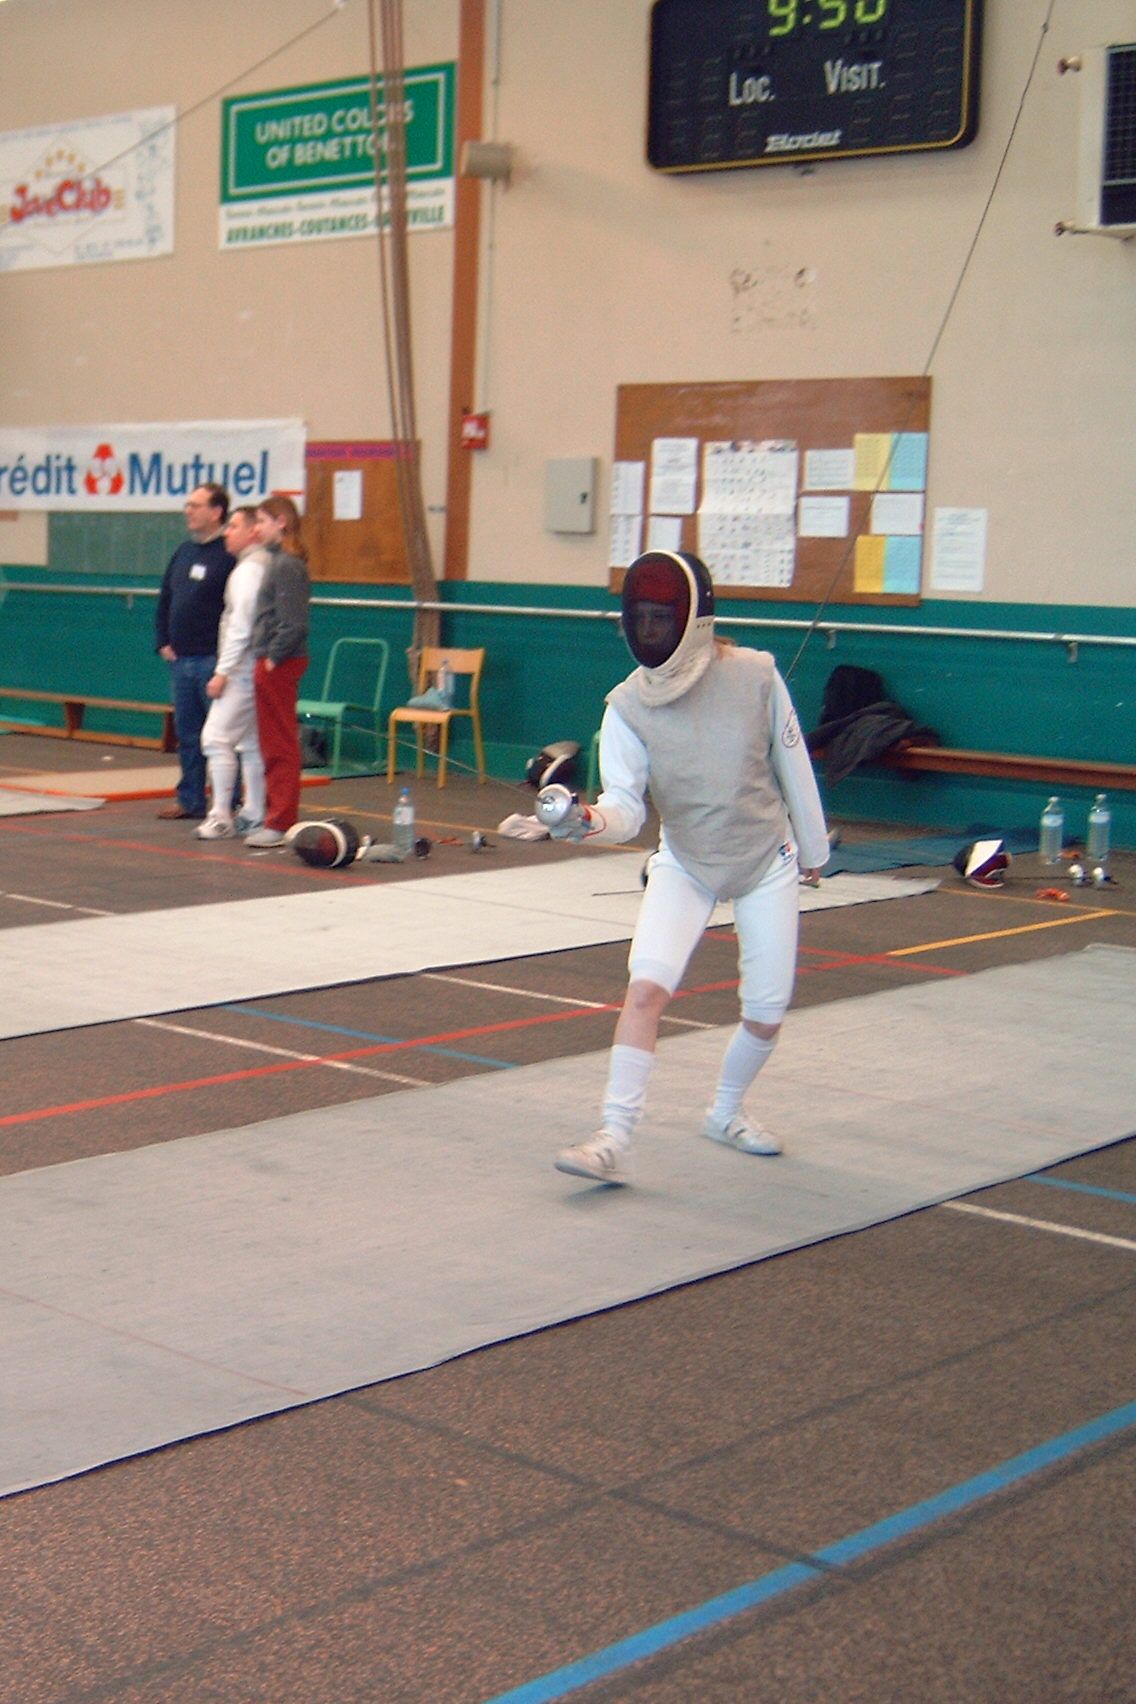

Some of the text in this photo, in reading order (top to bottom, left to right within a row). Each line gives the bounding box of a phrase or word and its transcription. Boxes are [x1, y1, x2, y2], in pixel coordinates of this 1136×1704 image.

[255, 112, 329, 144] UNITED
[266, 144, 292, 169] OF
[128, 450, 269, 496] Mutuel
